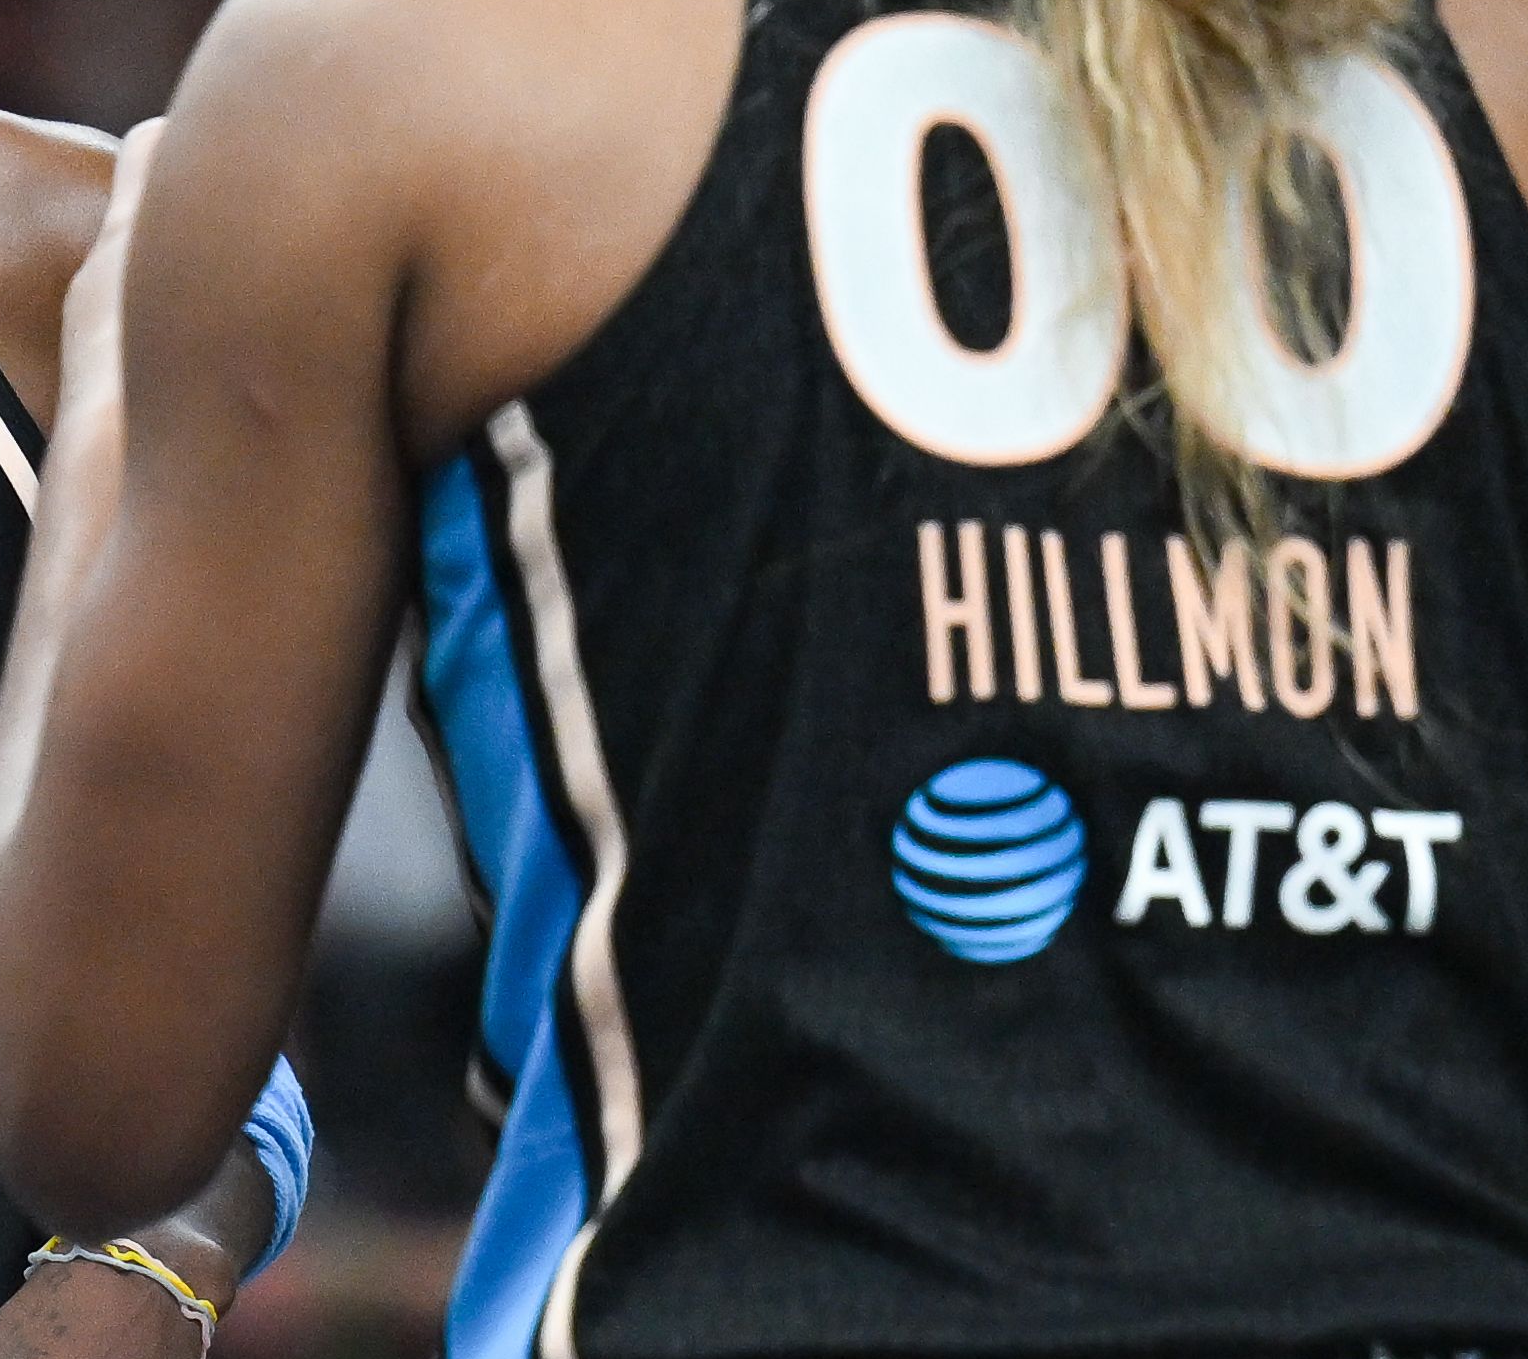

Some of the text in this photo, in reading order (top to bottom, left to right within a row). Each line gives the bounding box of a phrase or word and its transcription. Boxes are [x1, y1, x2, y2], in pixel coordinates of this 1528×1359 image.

[801, 11, 1476, 482] 00
[916, 519, 1421, 721] HILLMON
[1114, 797, 1463, 936] AT&T
